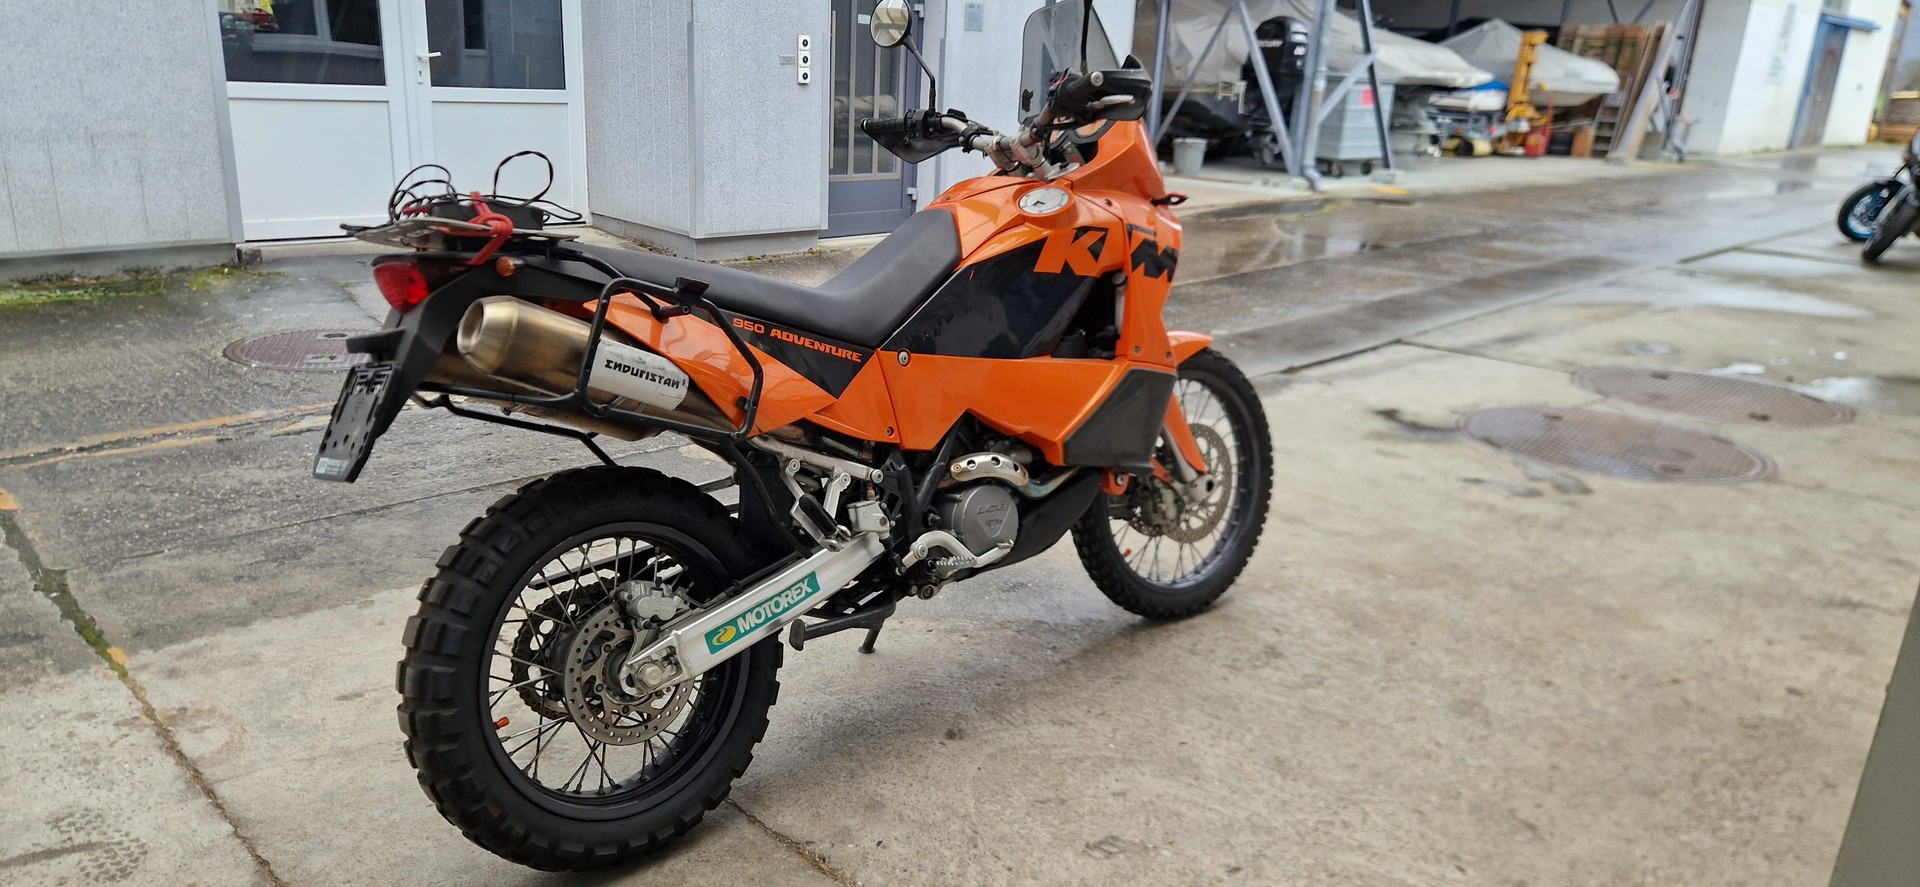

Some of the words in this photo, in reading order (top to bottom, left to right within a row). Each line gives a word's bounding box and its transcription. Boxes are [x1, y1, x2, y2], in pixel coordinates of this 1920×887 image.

[1034, 224, 1178, 284] KTM
[733, 317, 765, 334] 950
[770, 328, 862, 363] ADVENTURE
[604, 359, 680, 389] ENDURISTAN
[737, 578, 812, 634] MOTOREX
